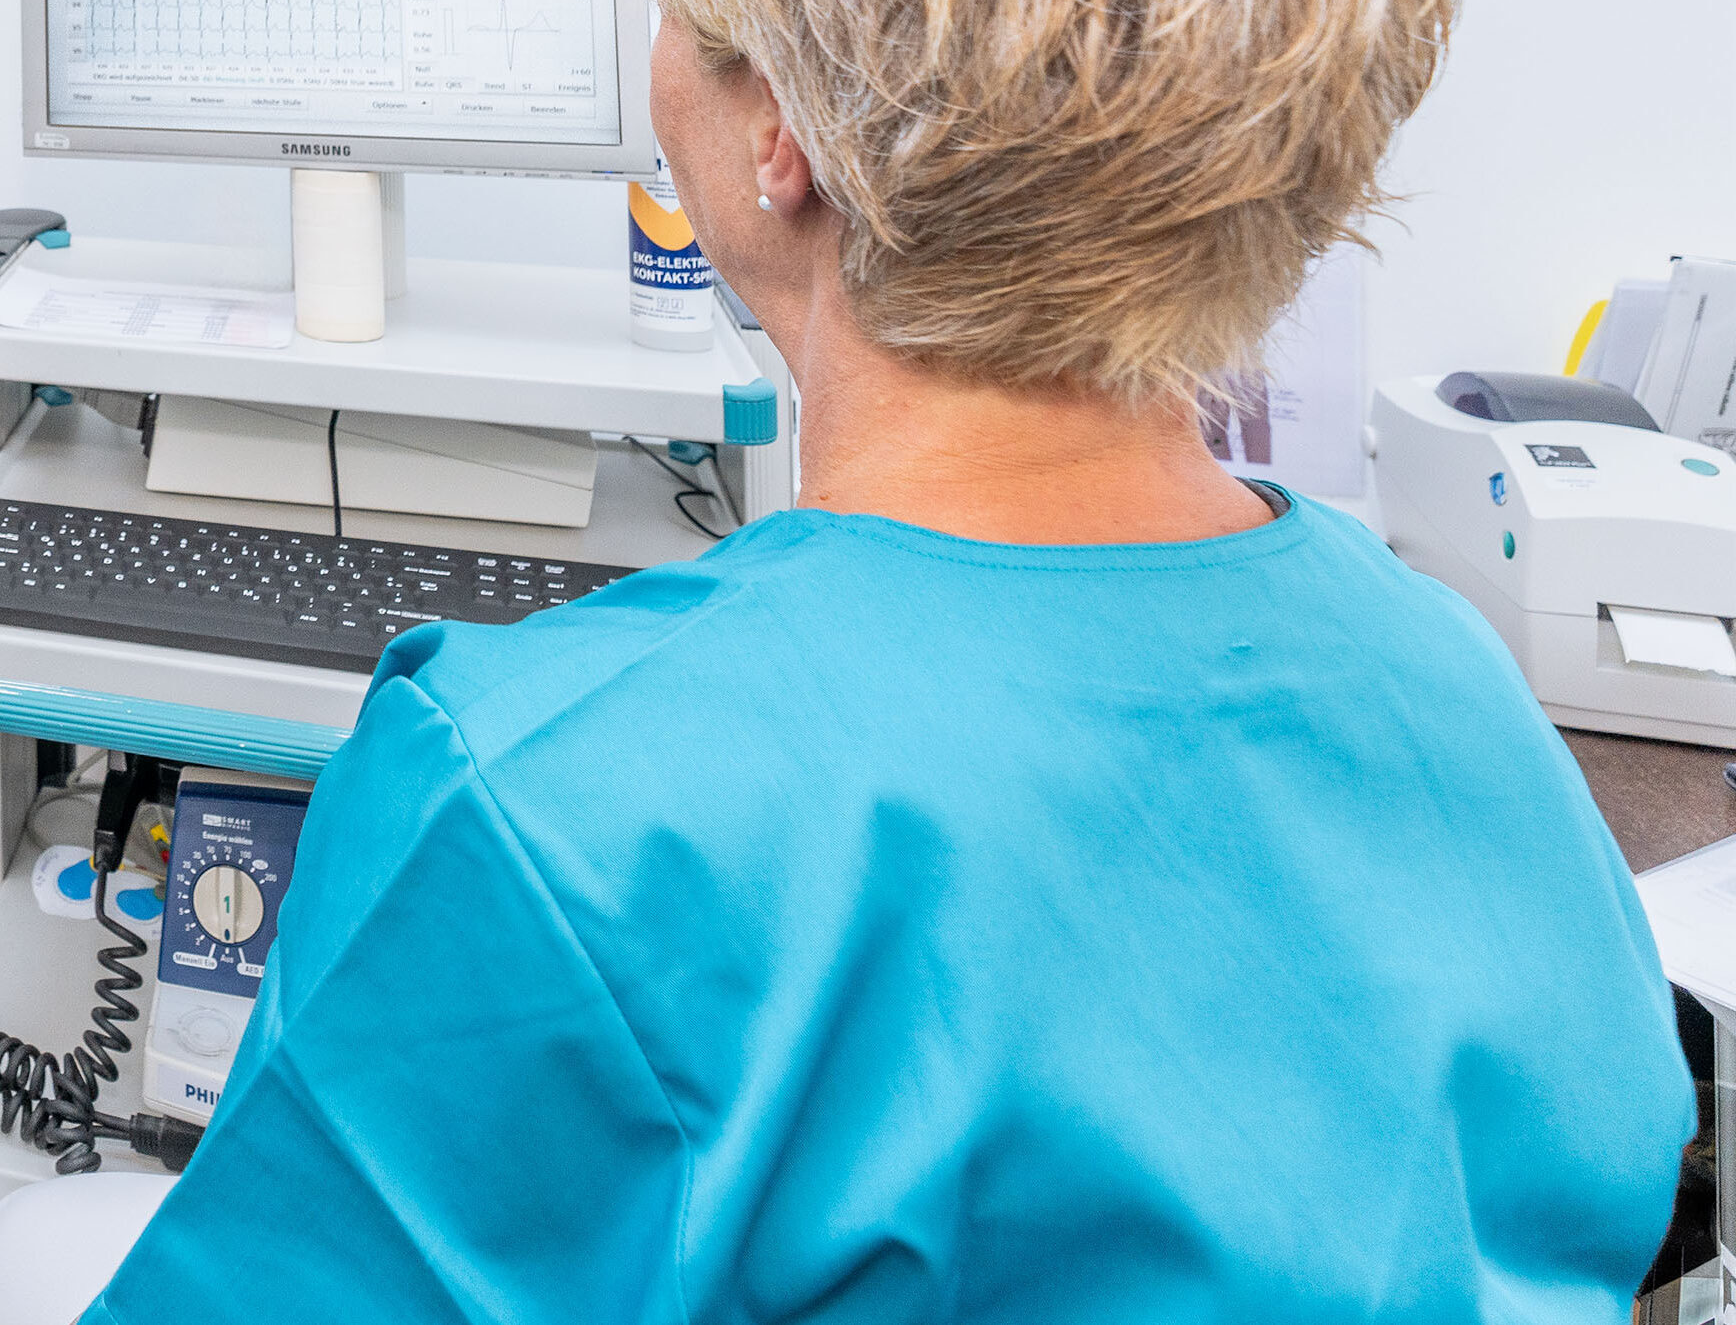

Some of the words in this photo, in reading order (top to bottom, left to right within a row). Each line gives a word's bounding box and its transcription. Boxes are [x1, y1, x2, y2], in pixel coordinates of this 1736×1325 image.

[371, 101, 409, 111] Optionen
[460, 102, 494, 112] Drucken
[529, 105, 567, 114] Beenden
[281, 142, 352, 157] SAMSUNG
[223, 895, 230, 914] 1
